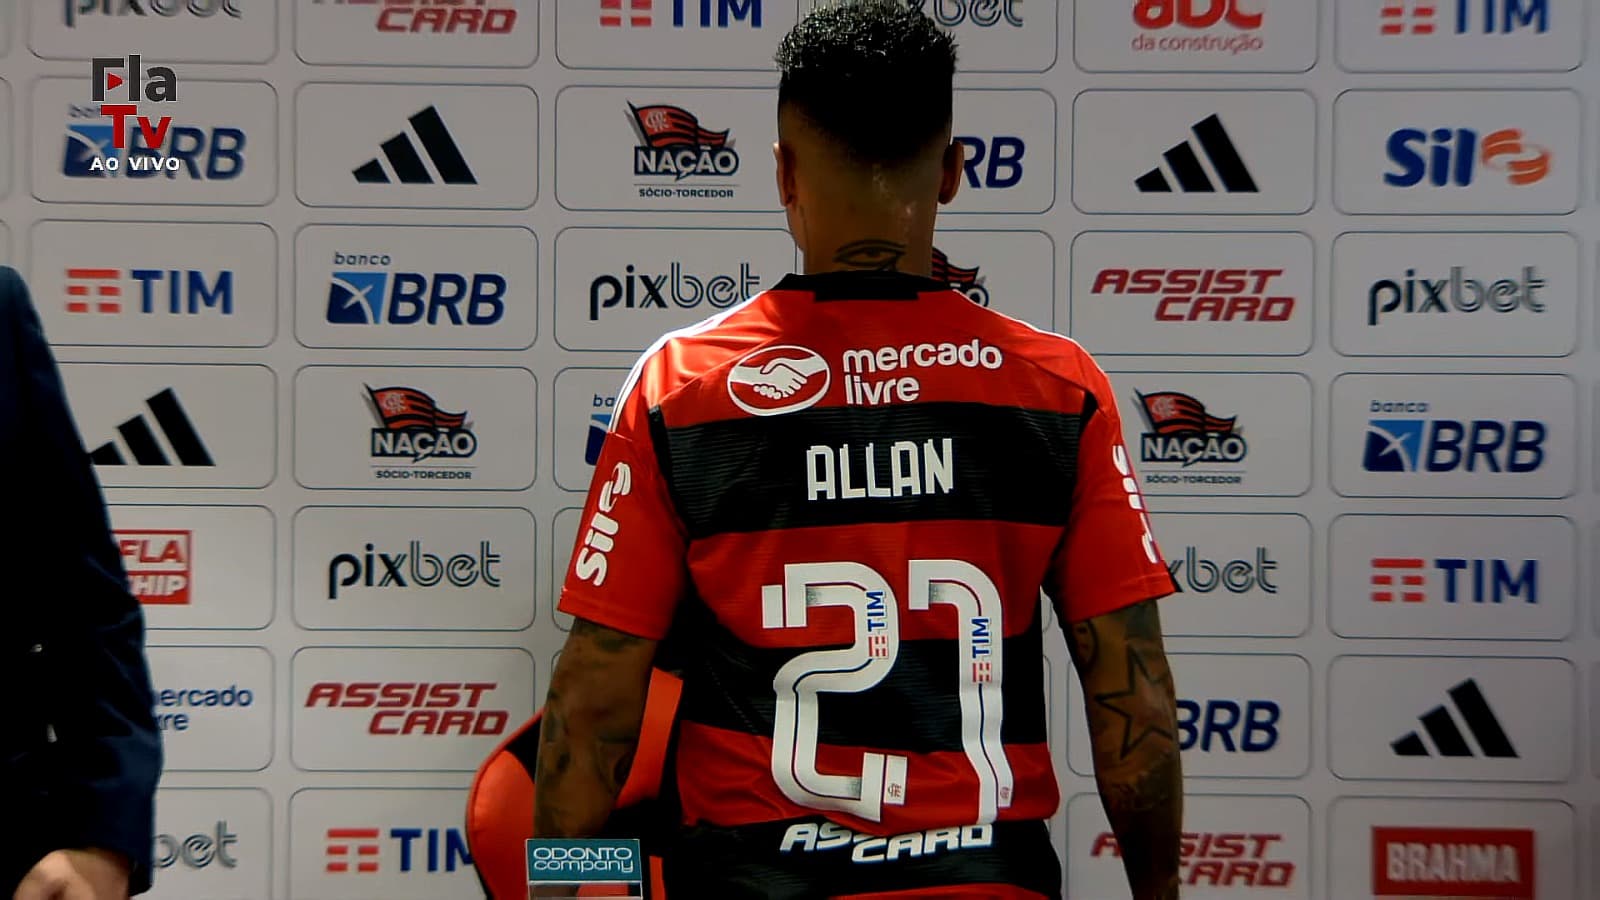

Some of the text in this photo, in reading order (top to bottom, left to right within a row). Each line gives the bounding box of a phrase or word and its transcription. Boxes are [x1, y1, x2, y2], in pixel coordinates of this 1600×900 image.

[375, 8, 518, 34] CARD
[1132, 34, 1264, 54] da construção
[636, 145, 738, 180] NAÇÃO
[951, 136, 1026, 189] RB
[1383, 128, 1477, 188] Sil
[333, 251, 391, 266] banco
[130, 269, 234, 315] TIM
[387, 272, 507, 326] BRB
[589, 262, 760, 321] pixbet
[1091, 269, 1284, 295] ASSIST
[1367, 266, 1546, 326] pixbet
[1154, 297, 1296, 322] CARD
[842, 338, 1003, 373] mercado
[844, 372, 920, 405] livre
[372, 427, 476, 462] NAÇÃO
[1142, 432, 1247, 467] NAÇÃO
[1425, 419, 1548, 474] BRB
[805, 438, 955, 501] ALLAN
[328, 540, 502, 600] pixbet
[1434, 558, 1539, 605] TIM
[866, 590, 886, 632] TIM
[971, 616, 992, 659] TIM
[153, 685, 254, 708] ercado
[304, 682, 498, 708] ASSIST
[368, 710, 510, 736] CARD
[533, 847, 633, 860] ODONTO
[533, 860, 634, 873] company
[1386, 841, 1521, 882] BRAHMA
[1180, 861, 1296, 888] ARD
